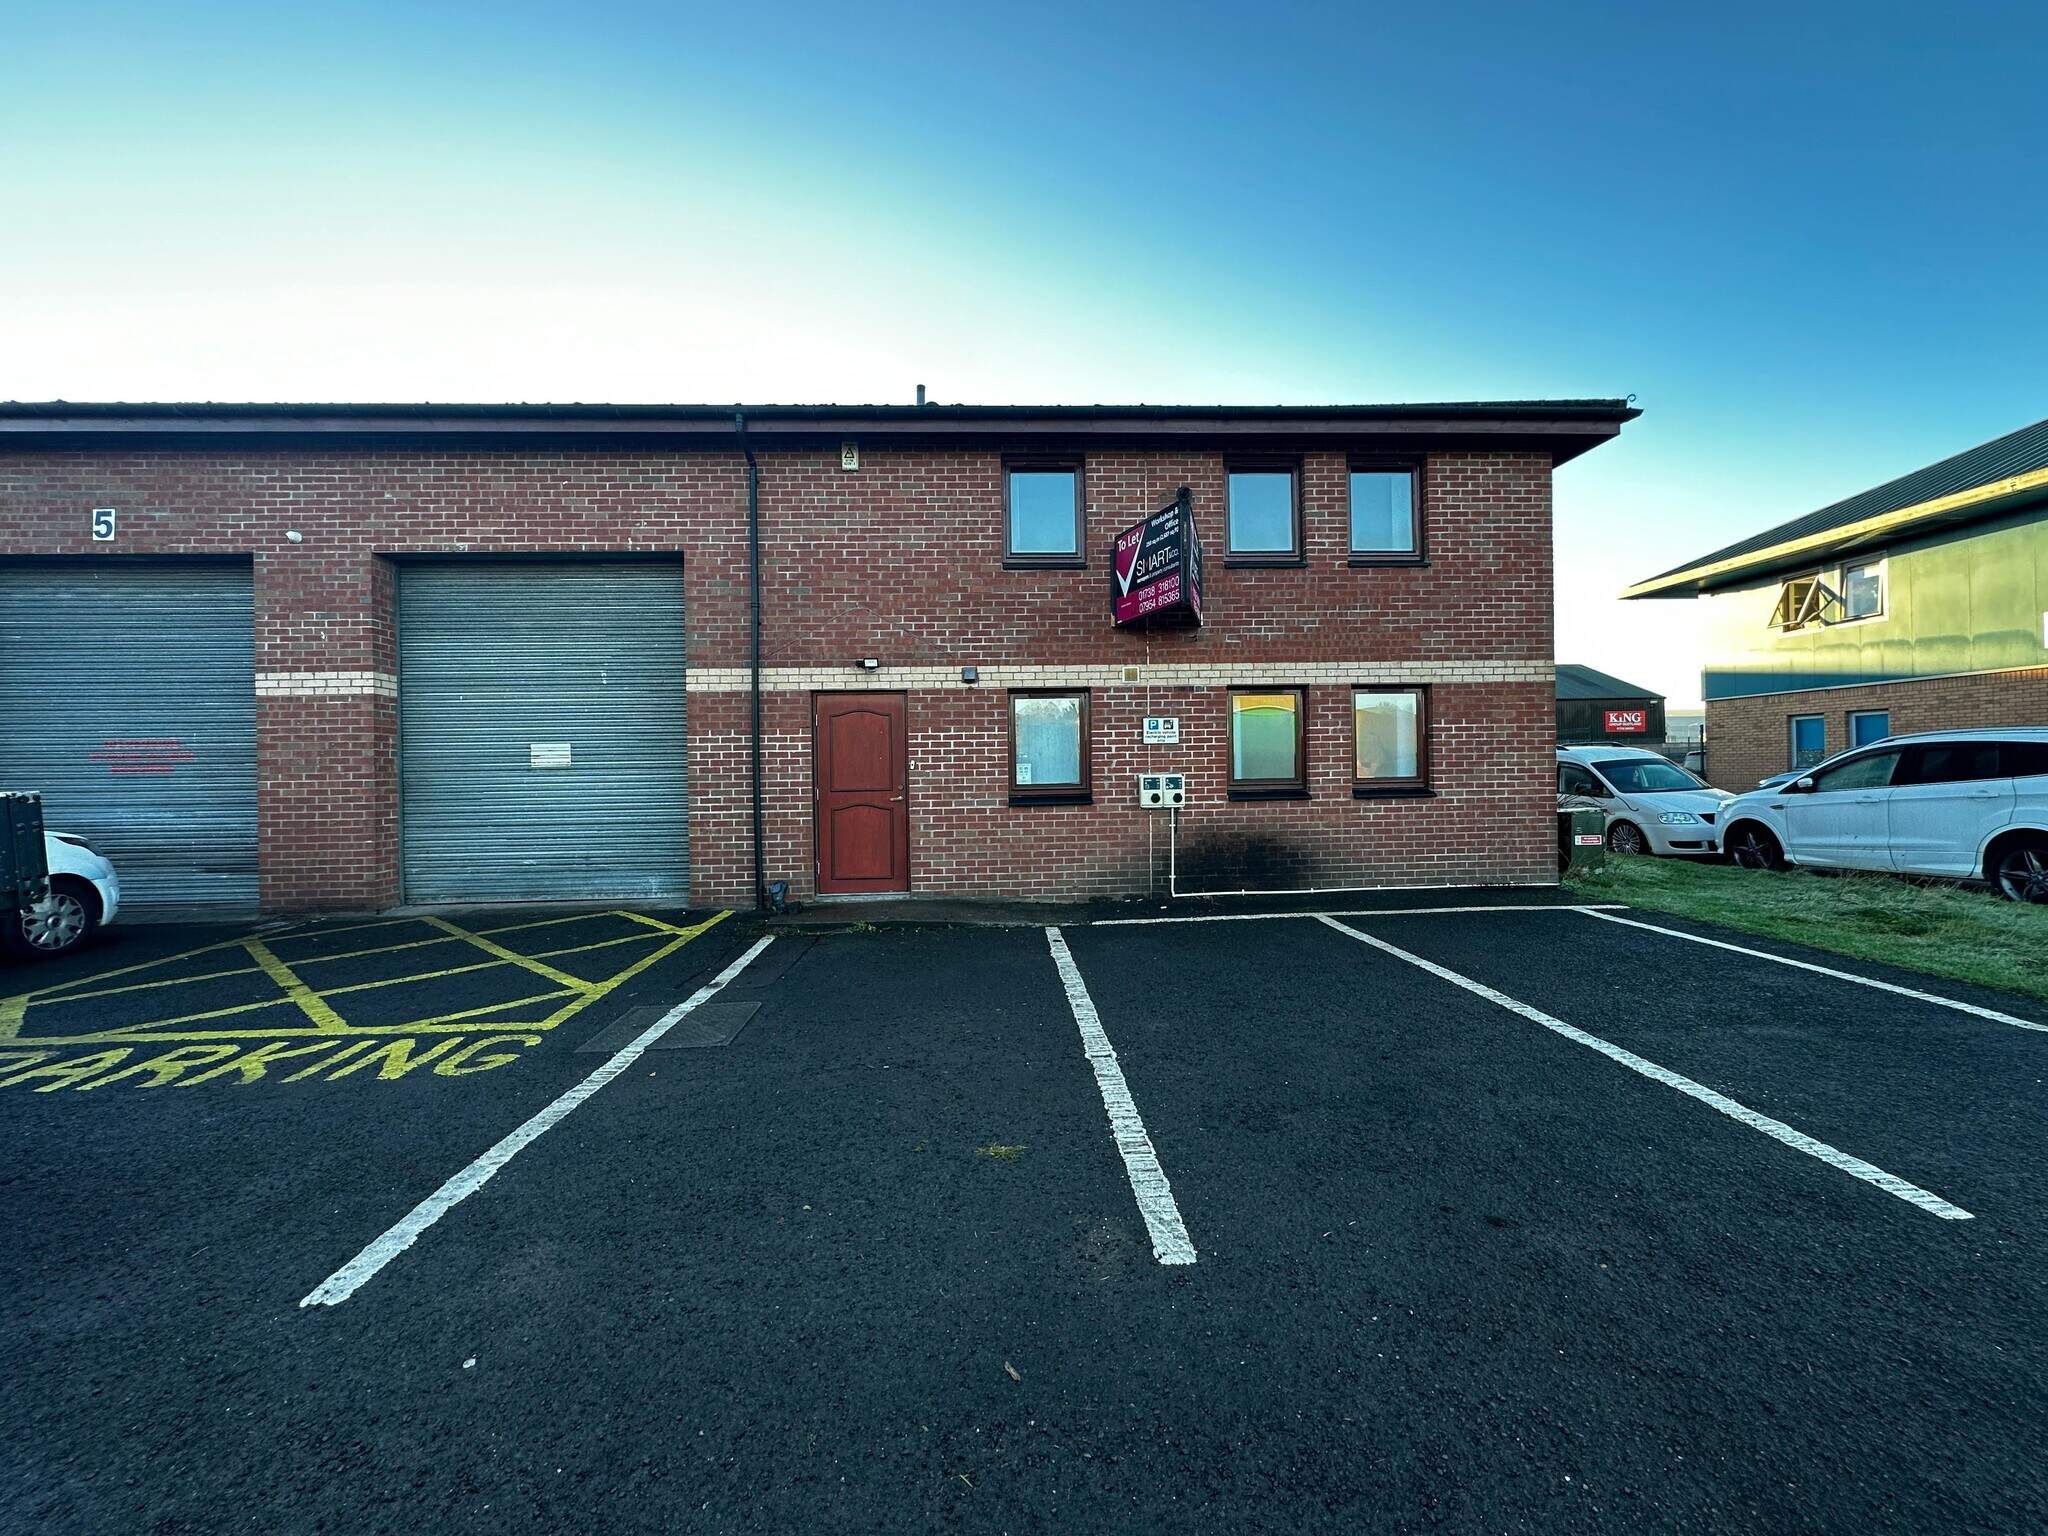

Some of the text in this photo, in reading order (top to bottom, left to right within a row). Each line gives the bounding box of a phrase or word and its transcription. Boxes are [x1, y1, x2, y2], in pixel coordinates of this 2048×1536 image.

[93, 511, 113, 538] 5
[1151, 510, 1174, 527] Workshop
[1164, 518, 1179, 530] Office
[1117, 531, 1140, 552] To Let
[1138, 575, 1180, 601] 01738 318100
[1139, 588, 1180, 613] 07954 815365
